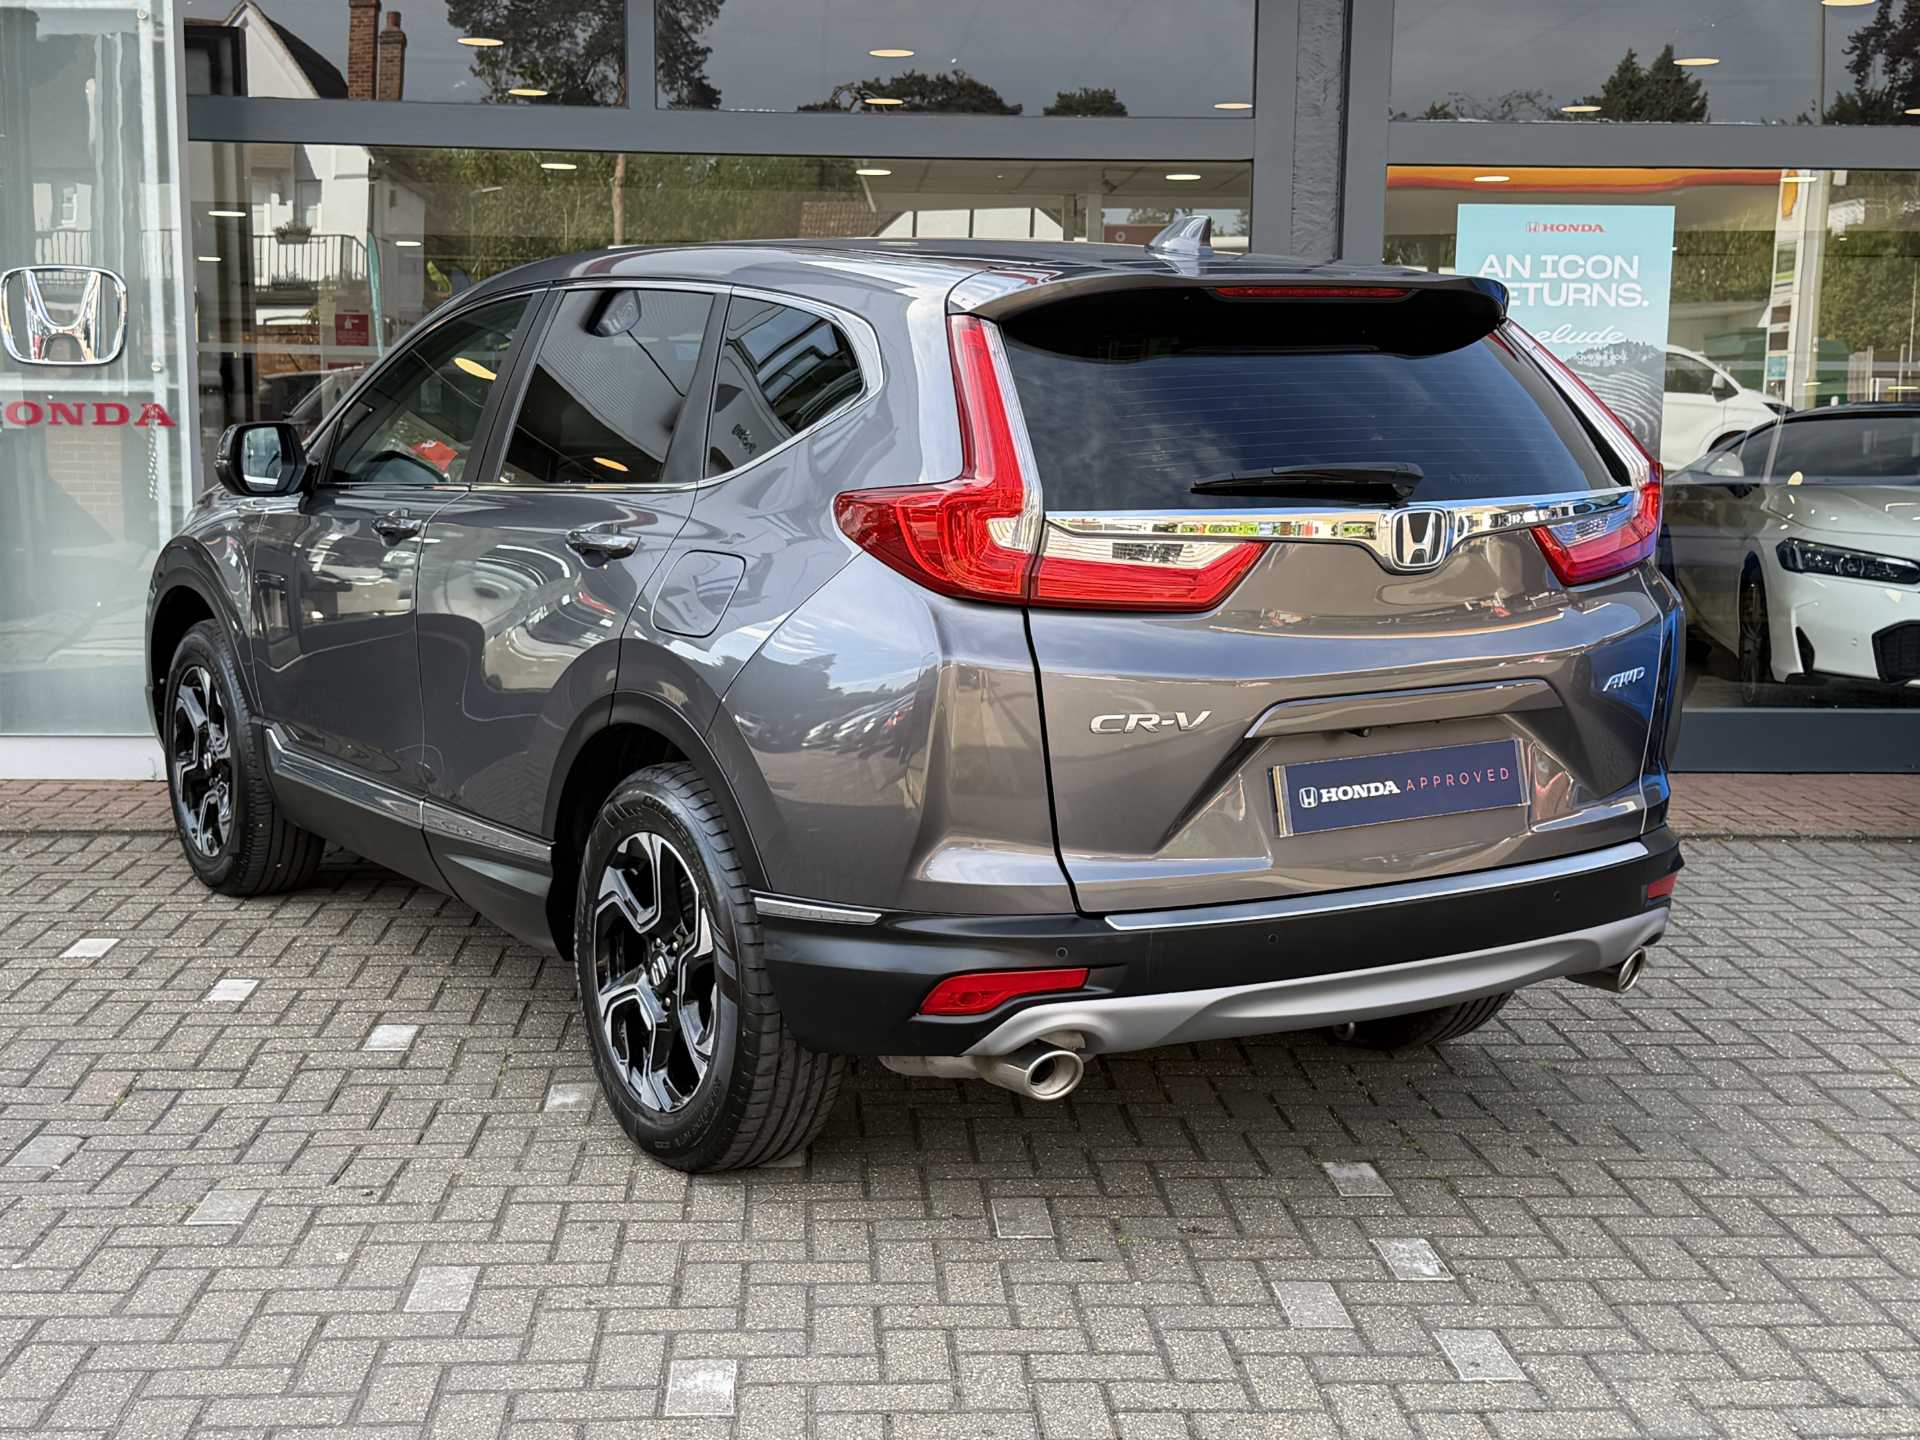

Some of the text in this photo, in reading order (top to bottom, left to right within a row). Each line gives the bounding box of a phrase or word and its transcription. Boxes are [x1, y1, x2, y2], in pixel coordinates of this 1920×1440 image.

[1543, 223, 1605, 233] HONDA
[1479, 254, 1640, 279] AN ICON
[1509, 282, 1649, 308] ETURNS.
[1534, 324, 1627, 344] elude
[0, 401, 176, 427] ONDA
[1090, 710, 1212, 734] CR-V
[1320, 780, 1401, 803] HONDA
[1406, 767, 1510, 792] APPROVED
